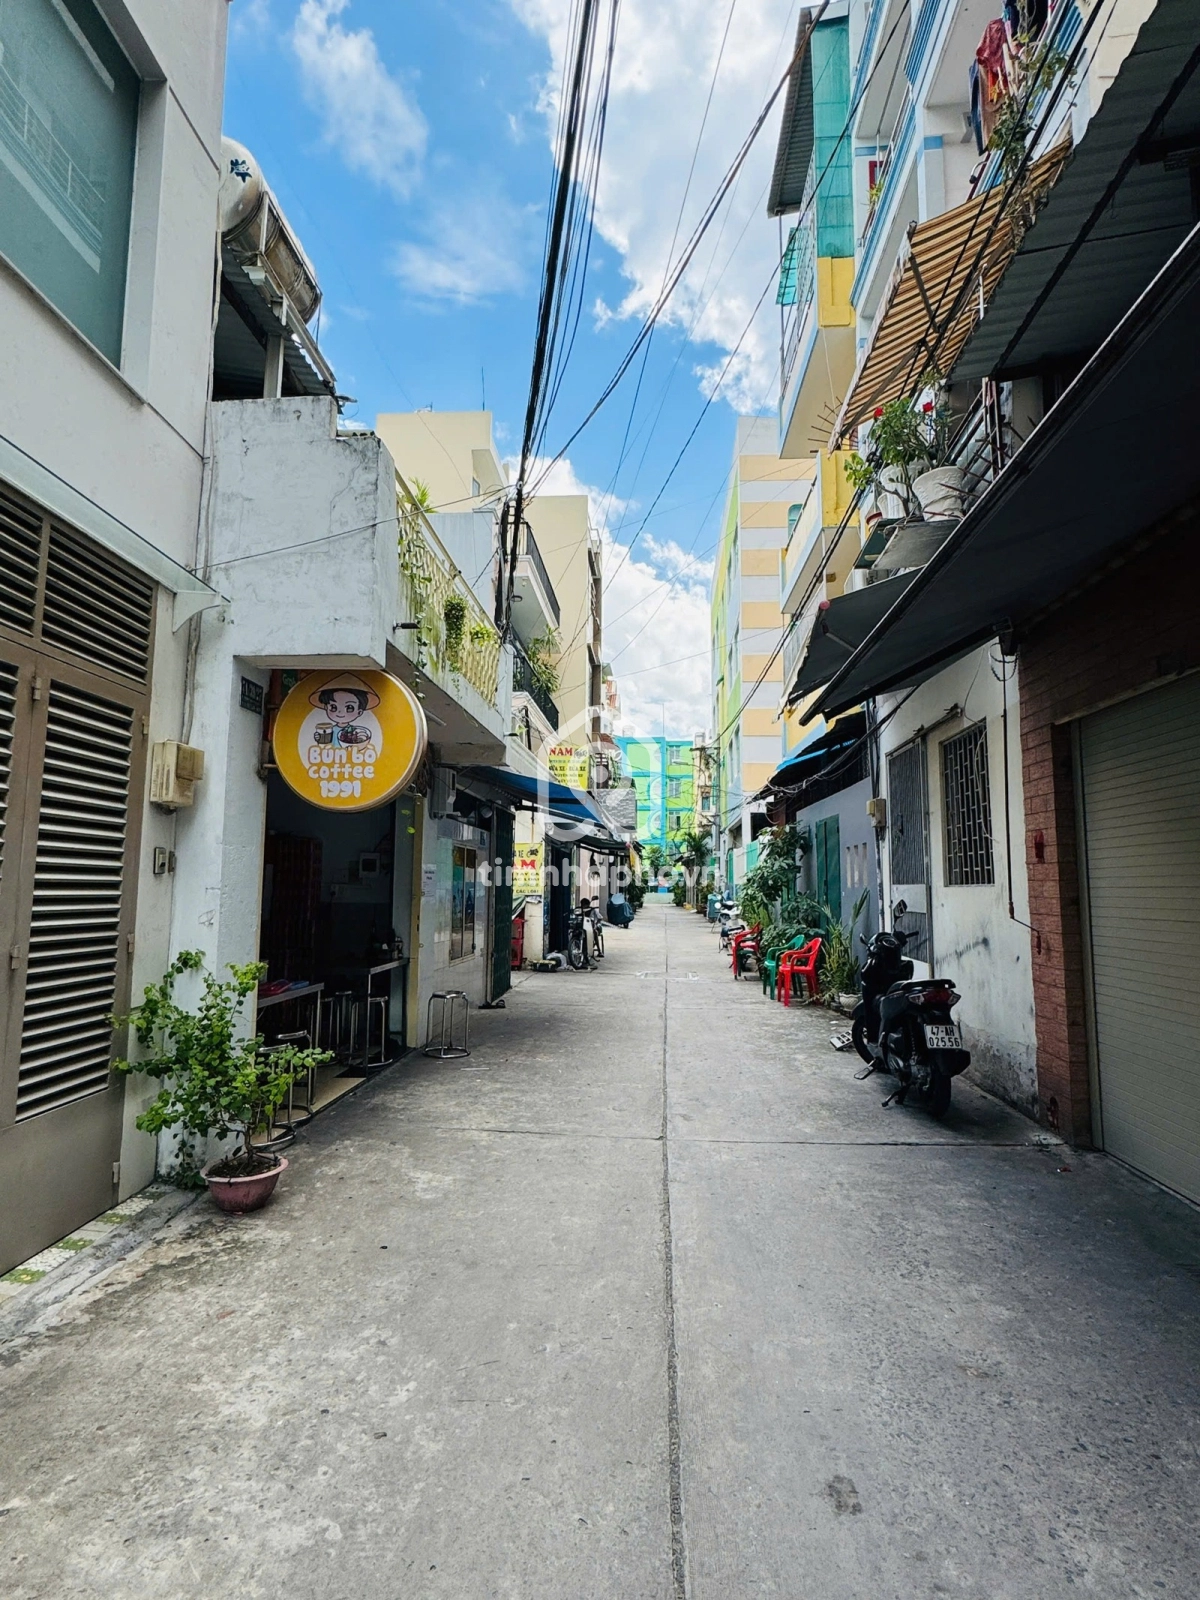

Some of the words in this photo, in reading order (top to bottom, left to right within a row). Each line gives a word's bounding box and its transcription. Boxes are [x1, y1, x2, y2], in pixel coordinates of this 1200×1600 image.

[309, 743, 347, 764] Bún
[352, 743, 376, 764] bò
[549, 747, 573, 756] NAM
[308, 764, 375, 779] coffee
[320, 780, 361, 798] 1991
[513, 859, 536, 869] AM
